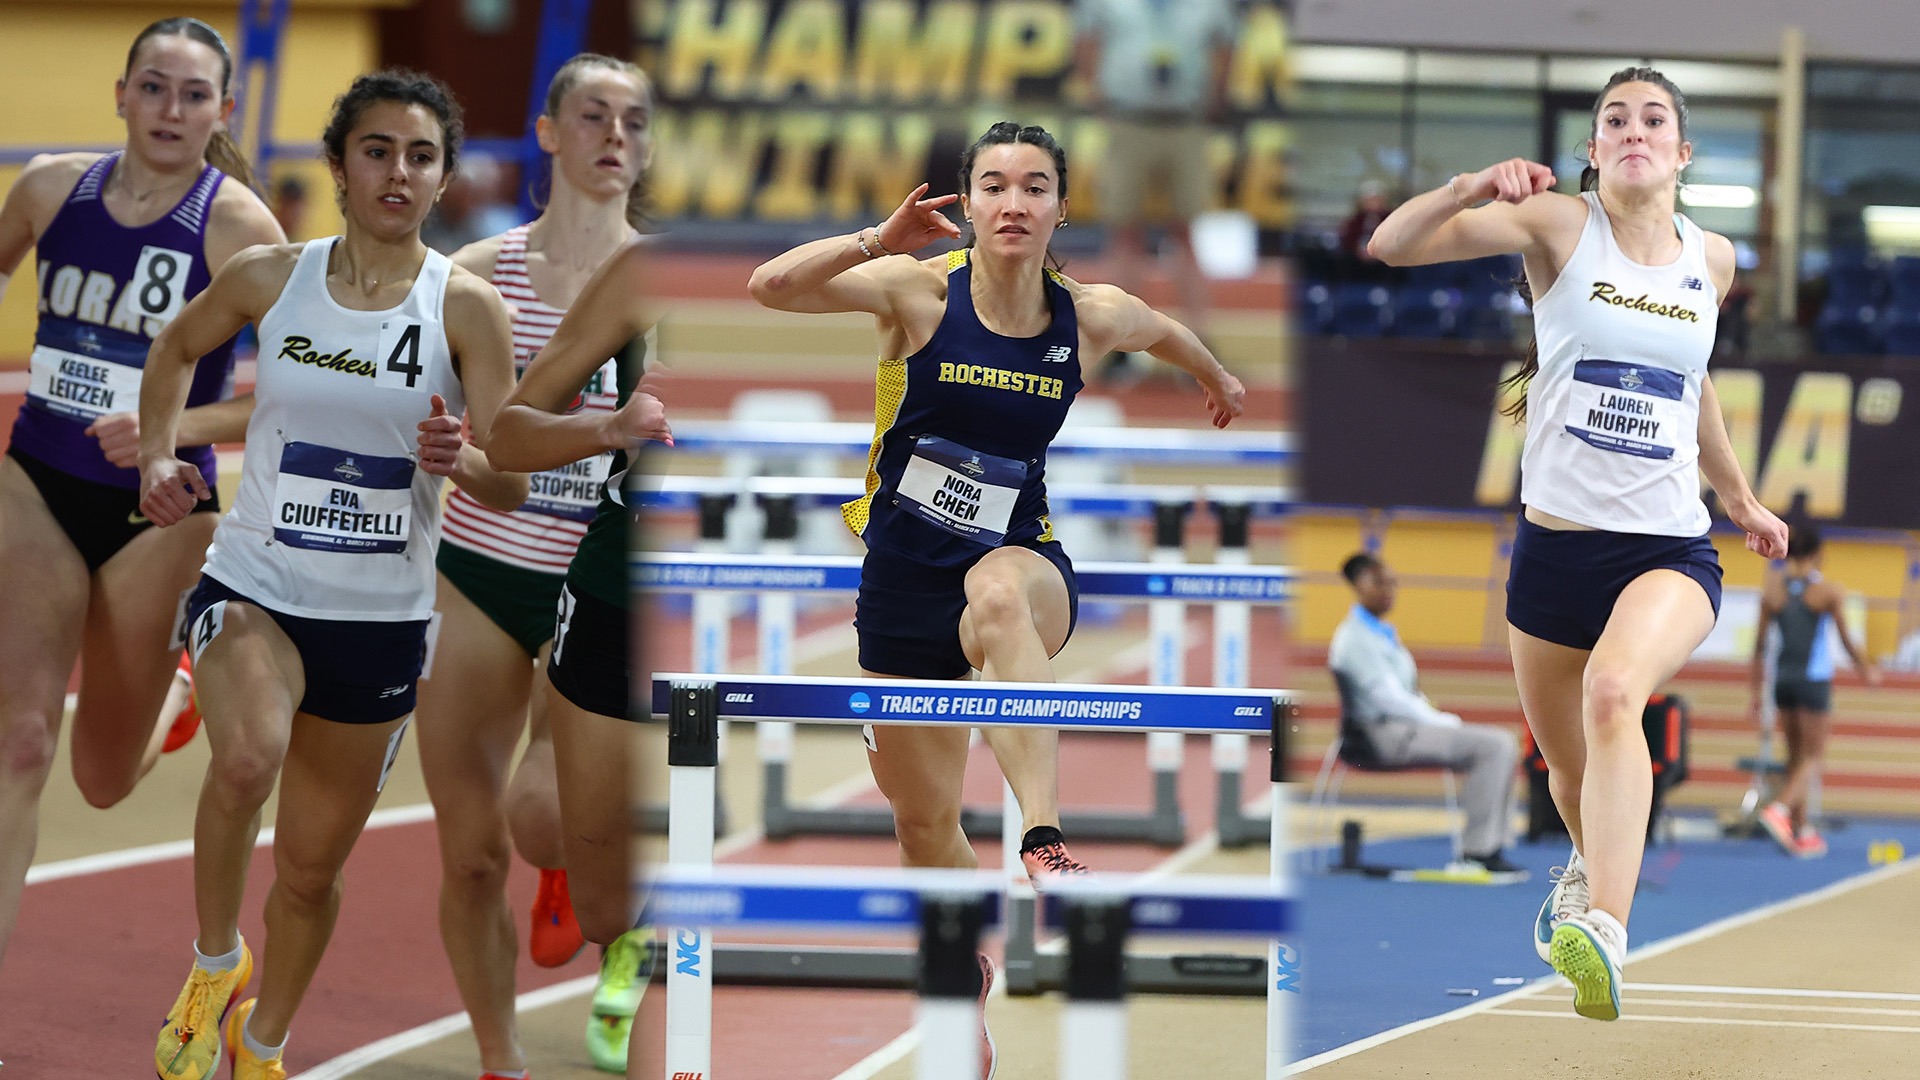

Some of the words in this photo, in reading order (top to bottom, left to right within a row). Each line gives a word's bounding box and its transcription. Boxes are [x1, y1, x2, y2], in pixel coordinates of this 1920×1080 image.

[139, 252, 177, 314] 8
[1589, 281, 1699, 323] Rochester
[58, 357, 110, 384] KEELEE
[387, 325, 423, 388] 4
[49, 375, 115, 409] LEITZEN
[938, 362, 1064, 400] ROCHESTER
[1599, 392, 1654, 416] LAUREN
[1586, 408, 1660, 440] MURPHY
[331, 489, 358, 508] EVA
[944, 475, 982, 501] NORA
[280, 501, 403, 536] CIUFFETELLI
[932, 489, 980, 521] CHEN
[196, 606, 217, 650] 4
[725, 692, 754, 704] GILL
[880, 695, 933, 714] TRACK
[936, 697, 949, 714] &
[951, 697, 997, 716] FIELD
[1000, 699, 1142, 720] CHAMPIONSHIPS
[1233, 706, 1263, 717] GILL
